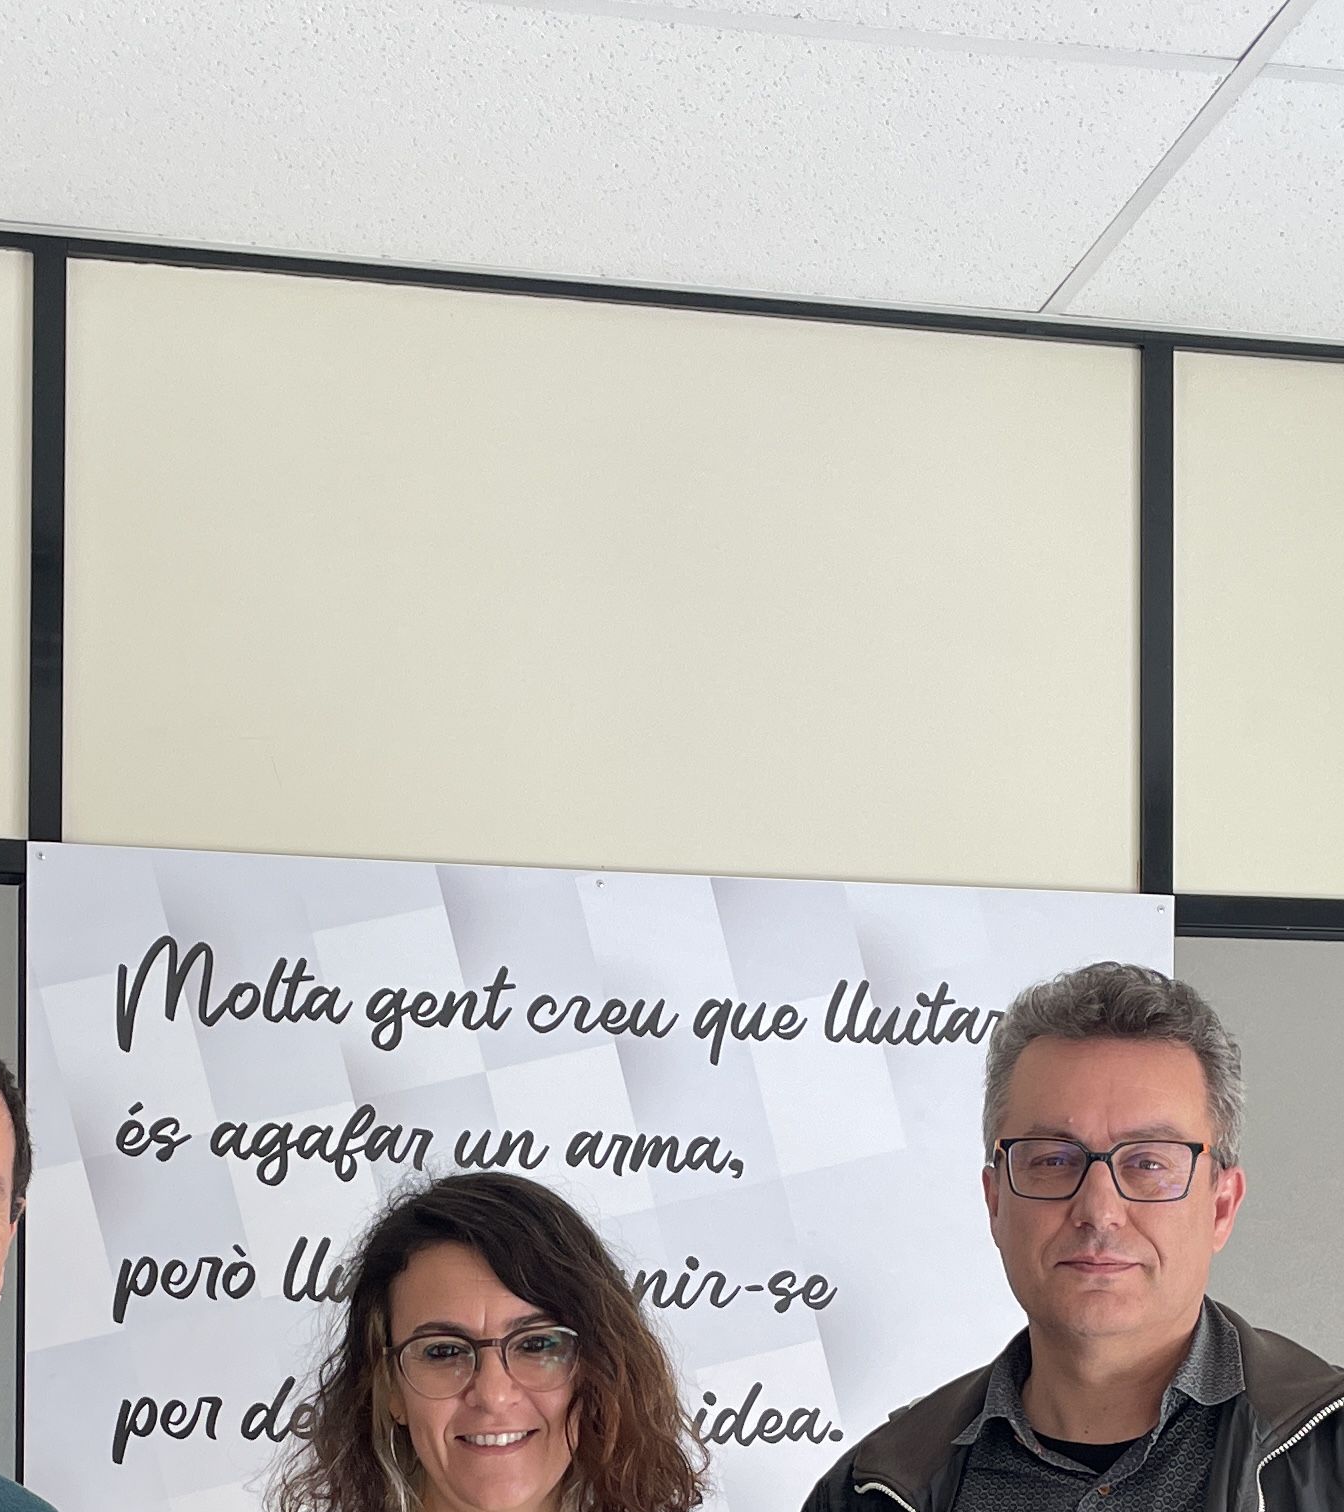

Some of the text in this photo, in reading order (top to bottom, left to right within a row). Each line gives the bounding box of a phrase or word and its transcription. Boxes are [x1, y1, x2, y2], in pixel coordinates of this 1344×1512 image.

[116, 935, 1006, 1067] Molta gent creu que lluitar
[115, 1101, 745, 1186] és agafar un arma,
[112, 1243, 256, 1324] però
[630, 1256, 838, 1314] nir-se
[111, 1396, 223, 1465] per
[692, 1381, 844, 1447] idea.
